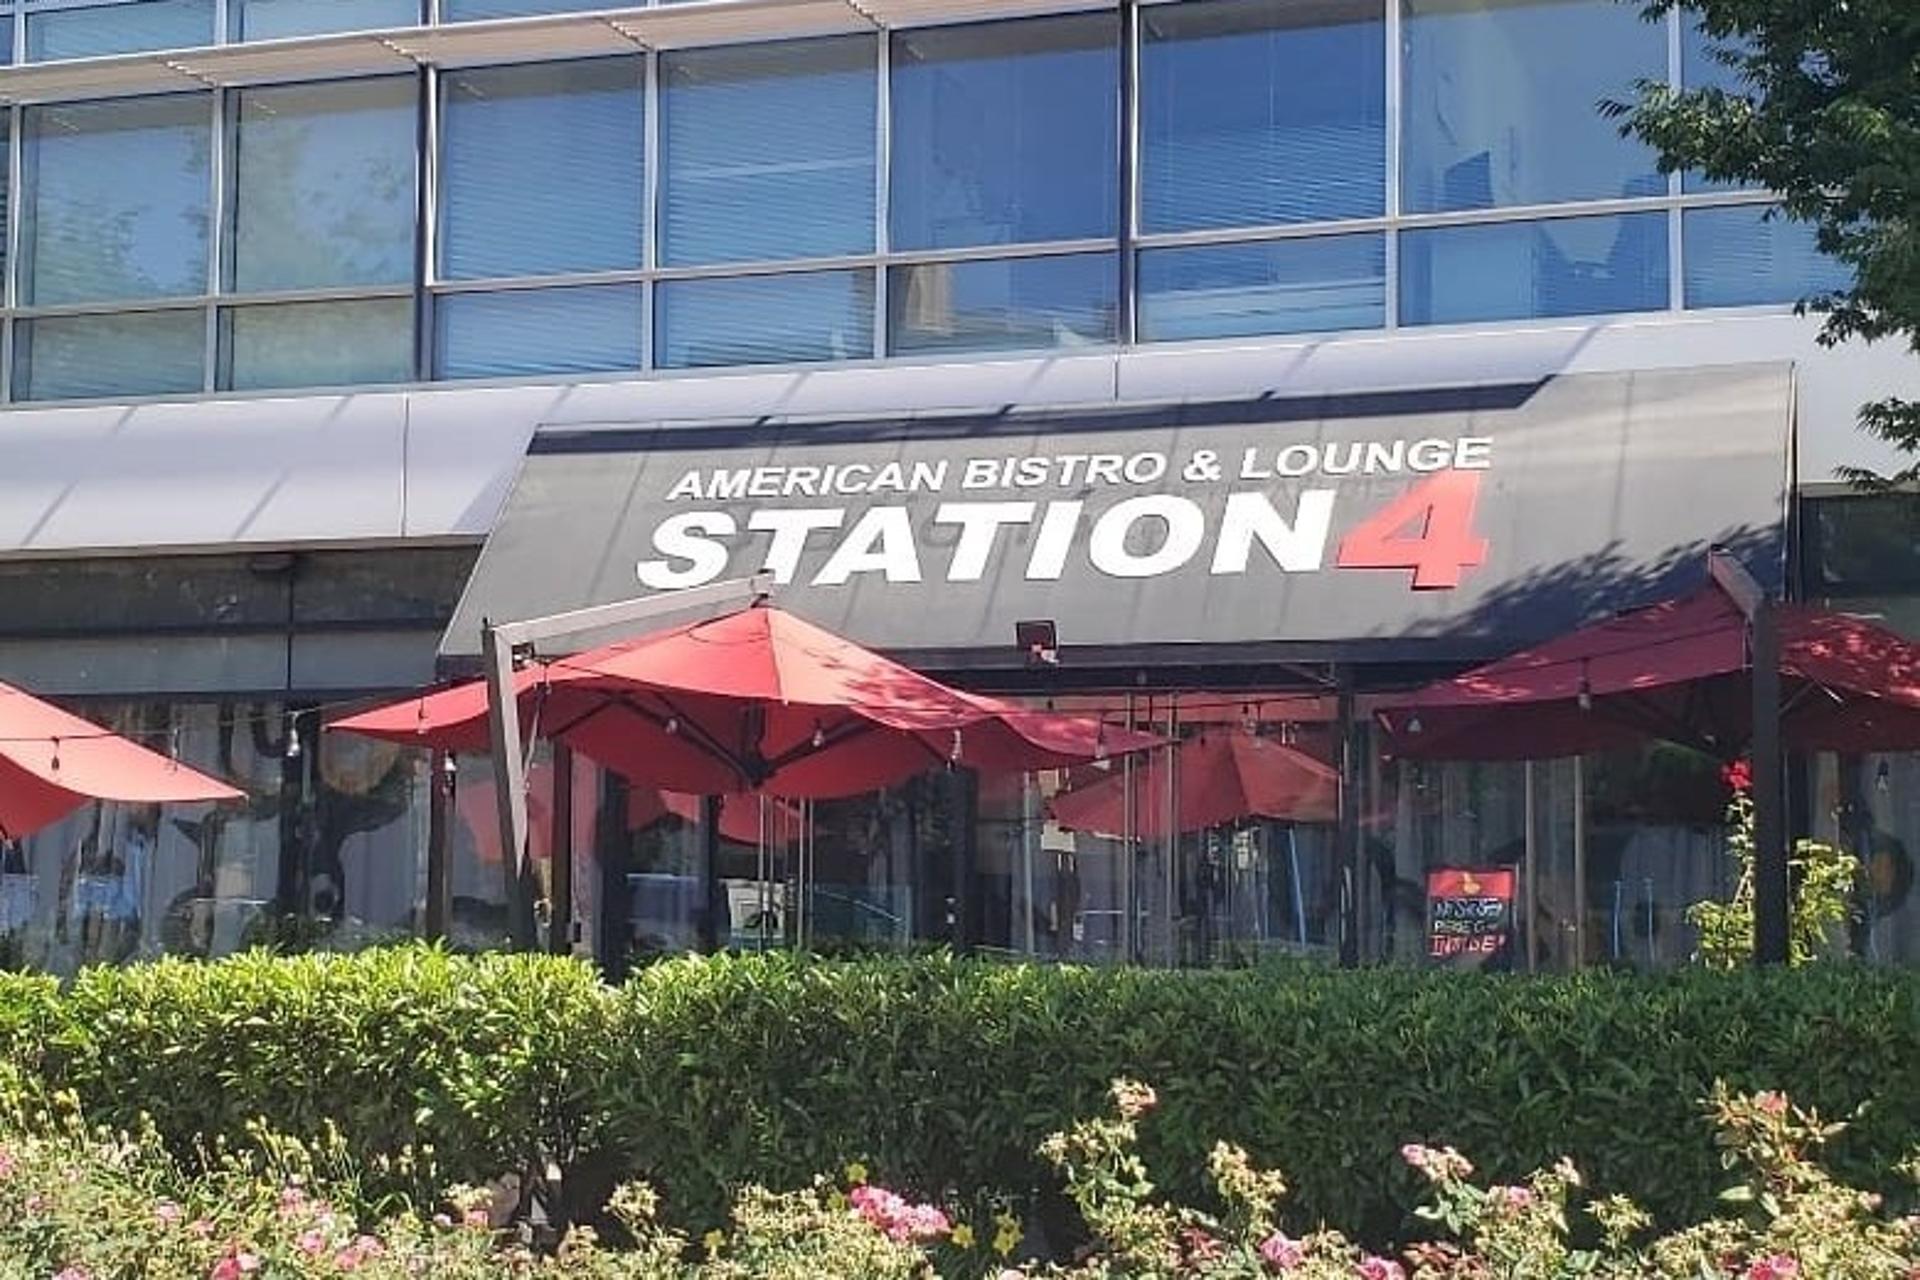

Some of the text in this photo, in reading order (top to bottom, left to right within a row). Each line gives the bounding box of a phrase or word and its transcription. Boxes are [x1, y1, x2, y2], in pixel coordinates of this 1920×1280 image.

[665, 437, 1494, 501] AMERICAN BISTRO & LOUNGE
[636, 470, 1489, 590] STATION 4
